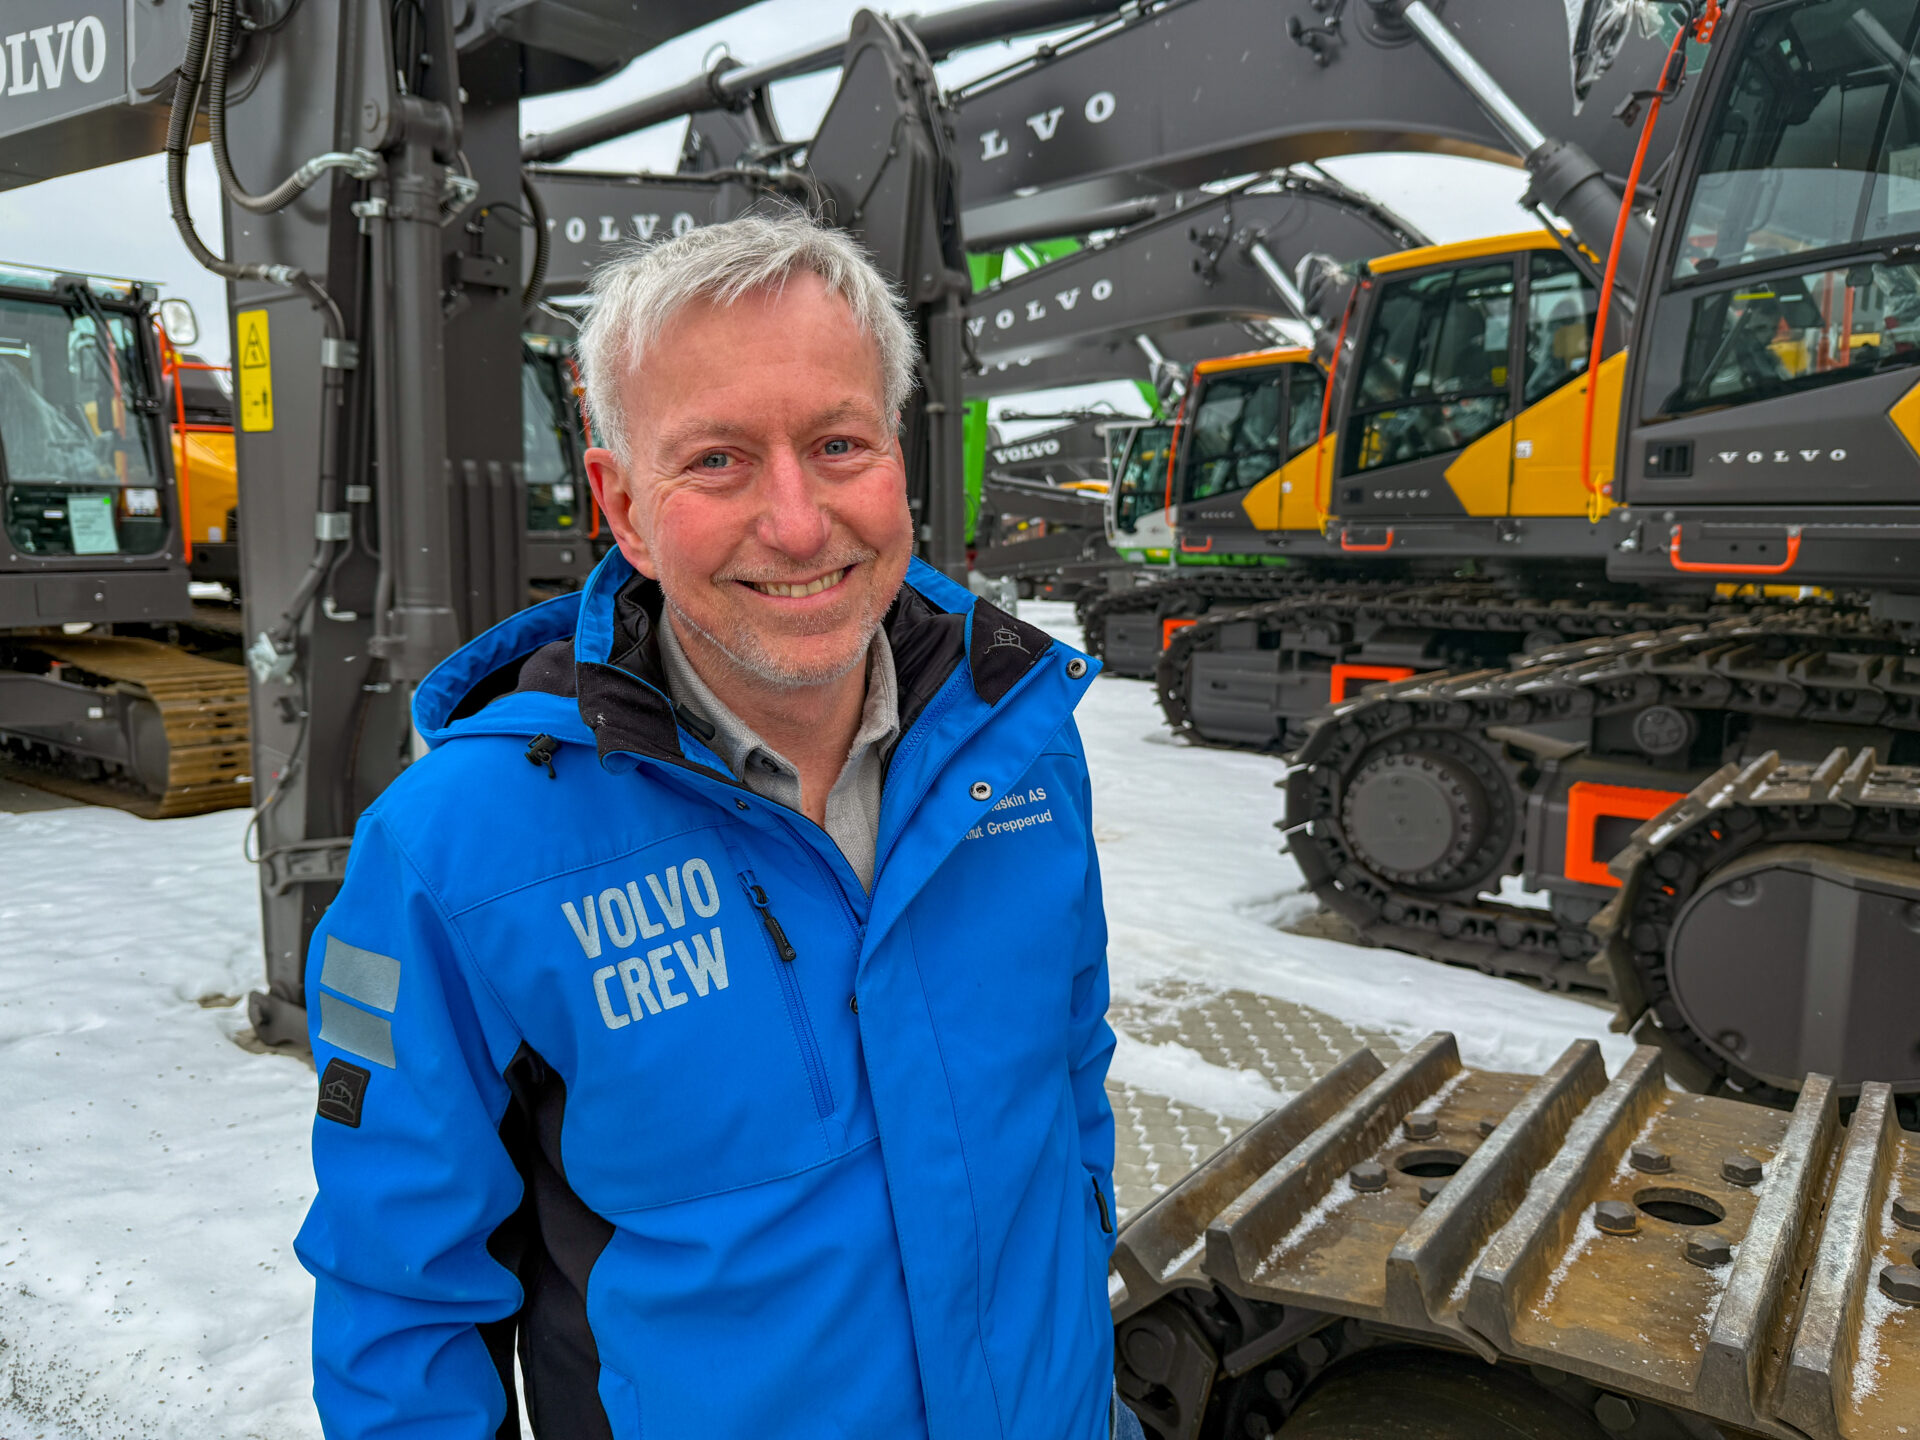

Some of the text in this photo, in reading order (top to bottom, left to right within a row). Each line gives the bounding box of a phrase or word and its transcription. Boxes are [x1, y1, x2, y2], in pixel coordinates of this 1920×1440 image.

[0, 15, 106, 96] LVO
[967, 279, 1113, 337] VOLVO
[992, 439, 1060, 464] VOLVO
[1718, 448, 1847, 464] VOLVO
[991, 787, 1047, 812] askin AS
[986, 808, 1053, 835] Grepperud
[560, 857, 721, 960] VOLVO
[592, 926, 729, 1030] CREW
